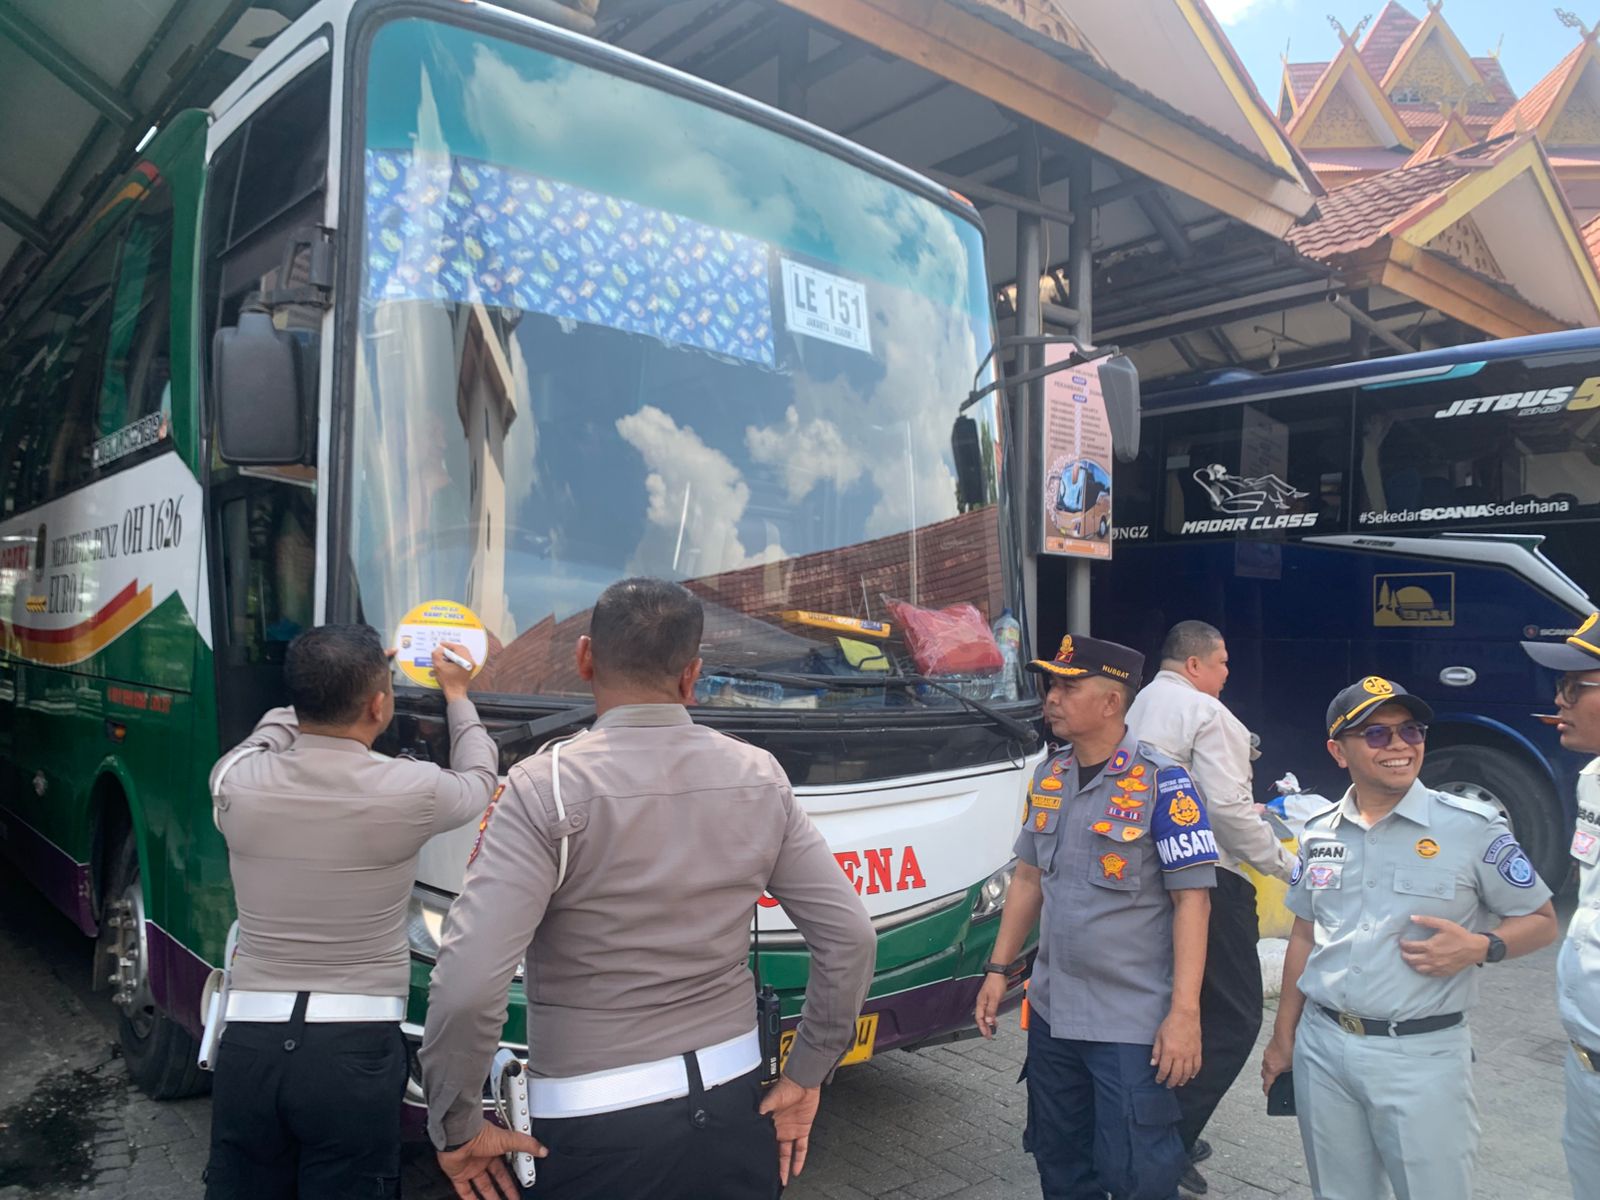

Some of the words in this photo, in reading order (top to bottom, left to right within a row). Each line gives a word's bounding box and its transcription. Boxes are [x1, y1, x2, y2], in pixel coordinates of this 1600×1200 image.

[793, 272, 818, 313] LE
[825, 285, 862, 329] 151
[1434, 386, 1575, 419] JETBUS
[122, 504, 147, 557] OH
[147, 494, 184, 552] 1626
[1181, 517, 1249, 535] MADAR
[1250, 513, 1319, 530] CLASS
[48, 572, 78, 614] EURO
[832, 846, 926, 896] ENA
